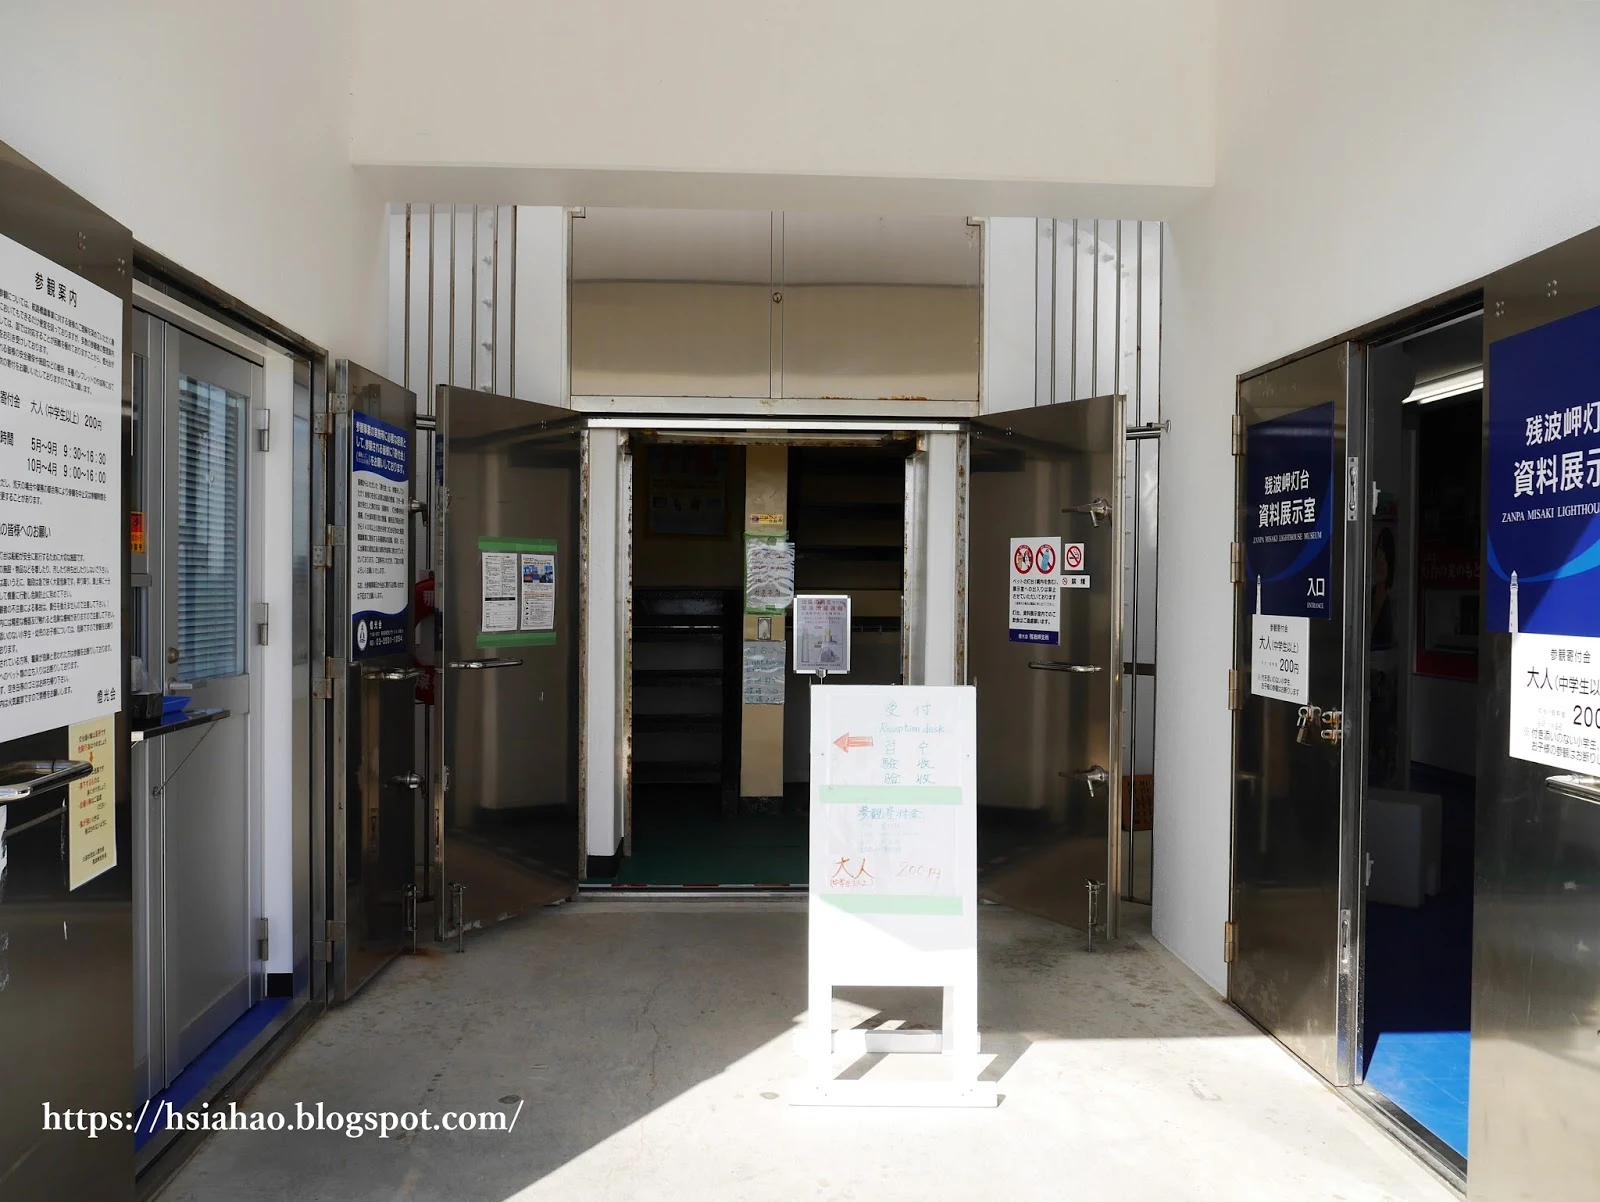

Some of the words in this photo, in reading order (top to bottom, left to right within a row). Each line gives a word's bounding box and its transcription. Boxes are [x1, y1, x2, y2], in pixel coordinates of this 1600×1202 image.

[35, 272, 77, 308] 参観案内
[85, 415, 102, 431] 200円
[1526, 400, 1600, 446] 残波岬灯
[31, 438, 57, 457] 5月～9月
[27, 458, 57, 477] 10月～4月
[1264, 469, 1310, 496] 残波岬灯台
[1258, 497, 1316, 529] 資料展示室
[1501, 511, 1525, 523] ZANPA
[1527, 507, 1555, 521] MISAKI
[1253, 534, 1265, 544] ZANPA
[1265, 533, 1278, 543] MISAKI
[1278, 532, 1303, 543] LIGHTHOUSE
[1304, 531, 1323, 541] MUSEUM
[1307, 577, 1325, 598] 入口
[1307, 602, 1325, 610] ENTRANCE
[1551, 648, 1591, 664] 参観寄付金
[1279, 658, 1300, 675] 200円
[885, 700, 931, 718] 受付
[923, 722, 945, 735] desk
[832, 857, 875, 880] 大人
[896, 861, 942, 880] 200円
